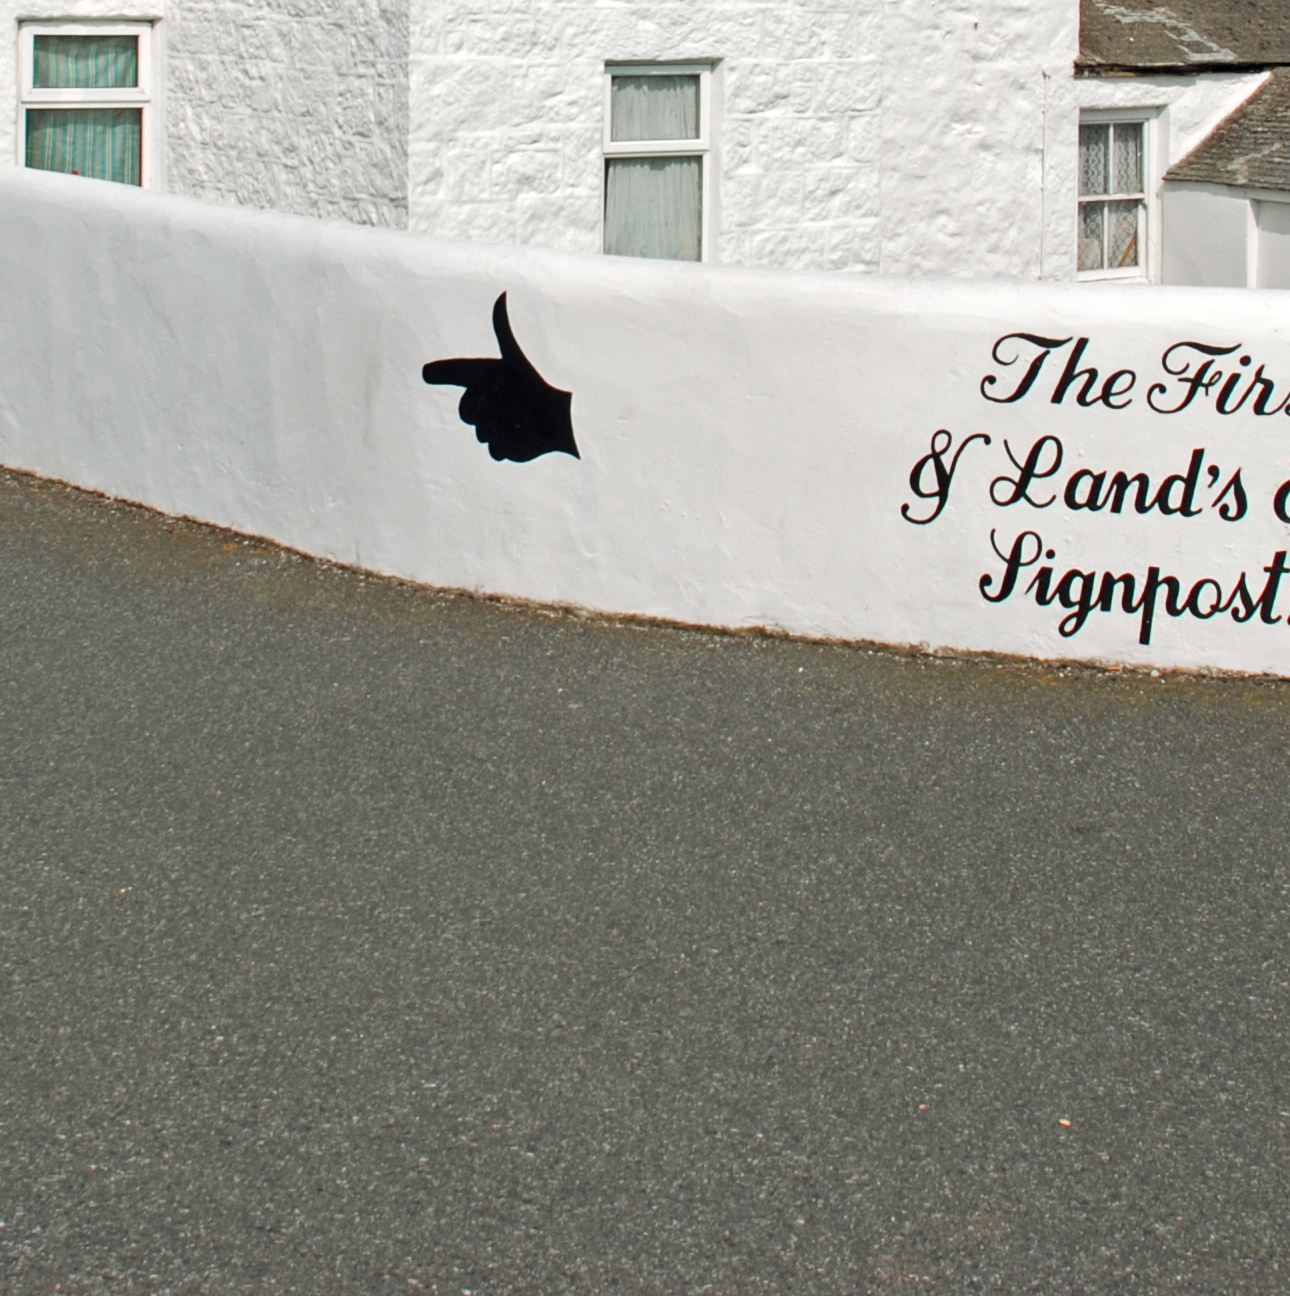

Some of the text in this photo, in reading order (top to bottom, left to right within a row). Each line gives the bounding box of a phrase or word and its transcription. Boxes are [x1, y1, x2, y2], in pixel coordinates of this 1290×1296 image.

[980, 332, 1137, 410] The
[900, 429, 992, 525] &
[989, 435, 1249, 523] Land's
